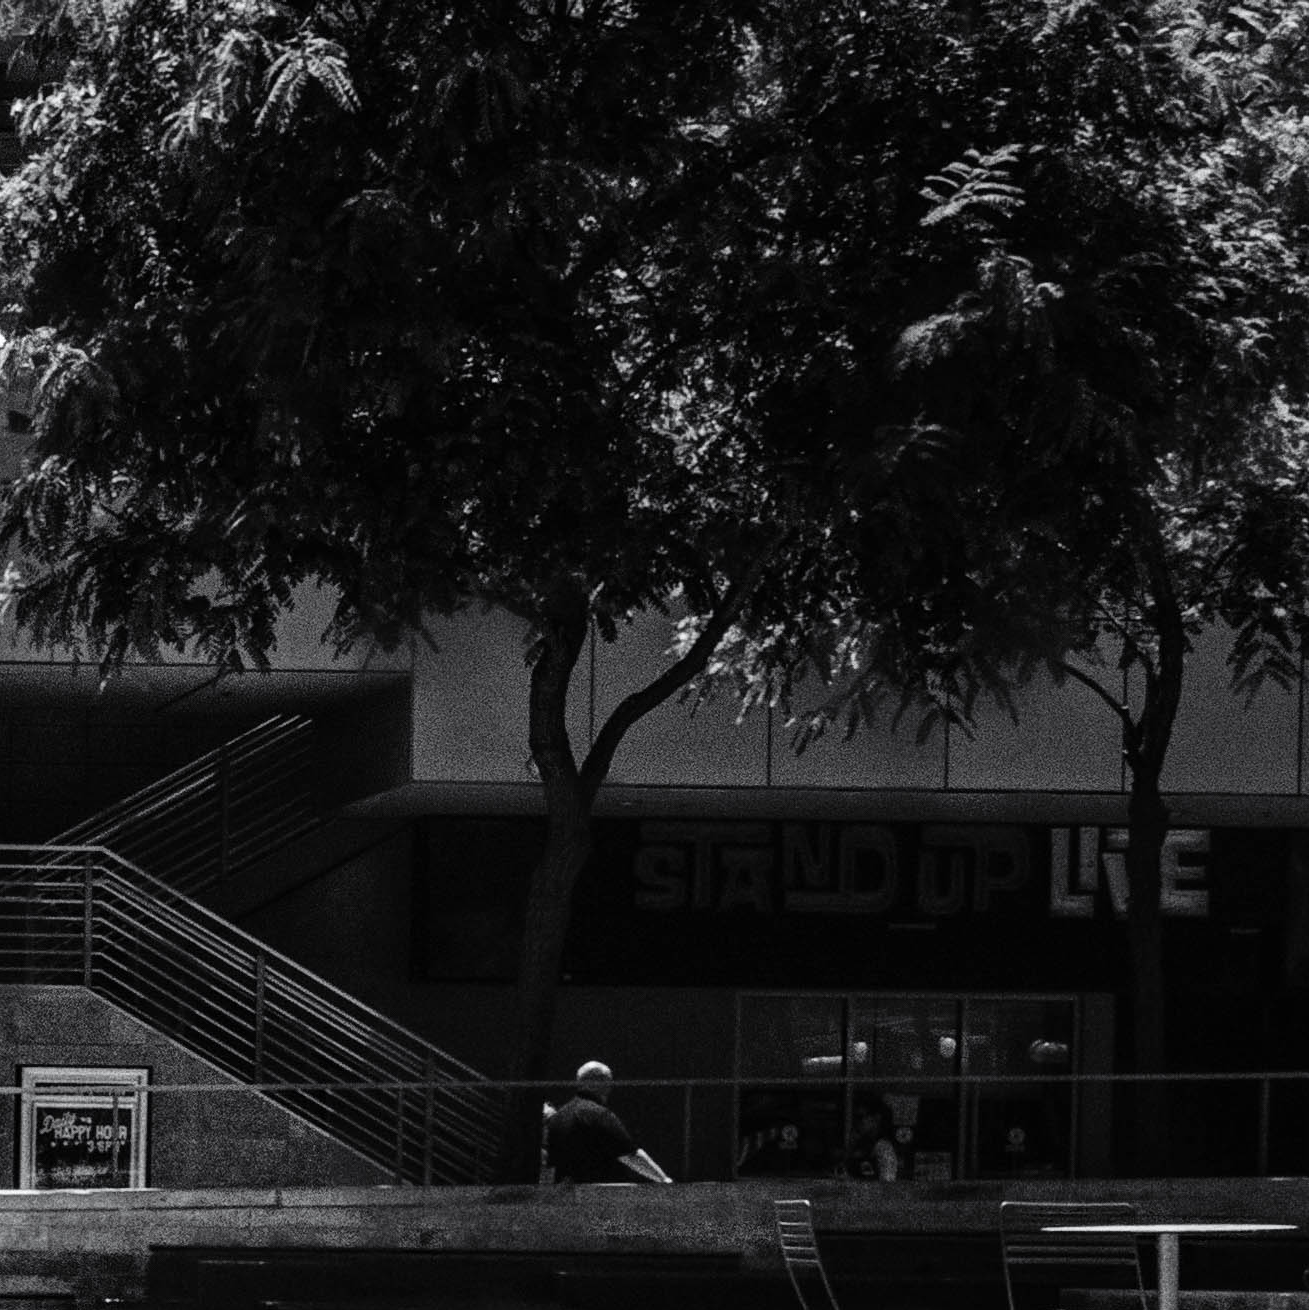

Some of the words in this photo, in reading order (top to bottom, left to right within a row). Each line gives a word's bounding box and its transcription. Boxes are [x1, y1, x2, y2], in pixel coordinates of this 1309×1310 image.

[634, 820, 897, 914] STAND
[919, 824, 1031, 915] UP
[54, 1125, 92, 1142] HAPPY
[96, 1125, 128, 1140] HOR
